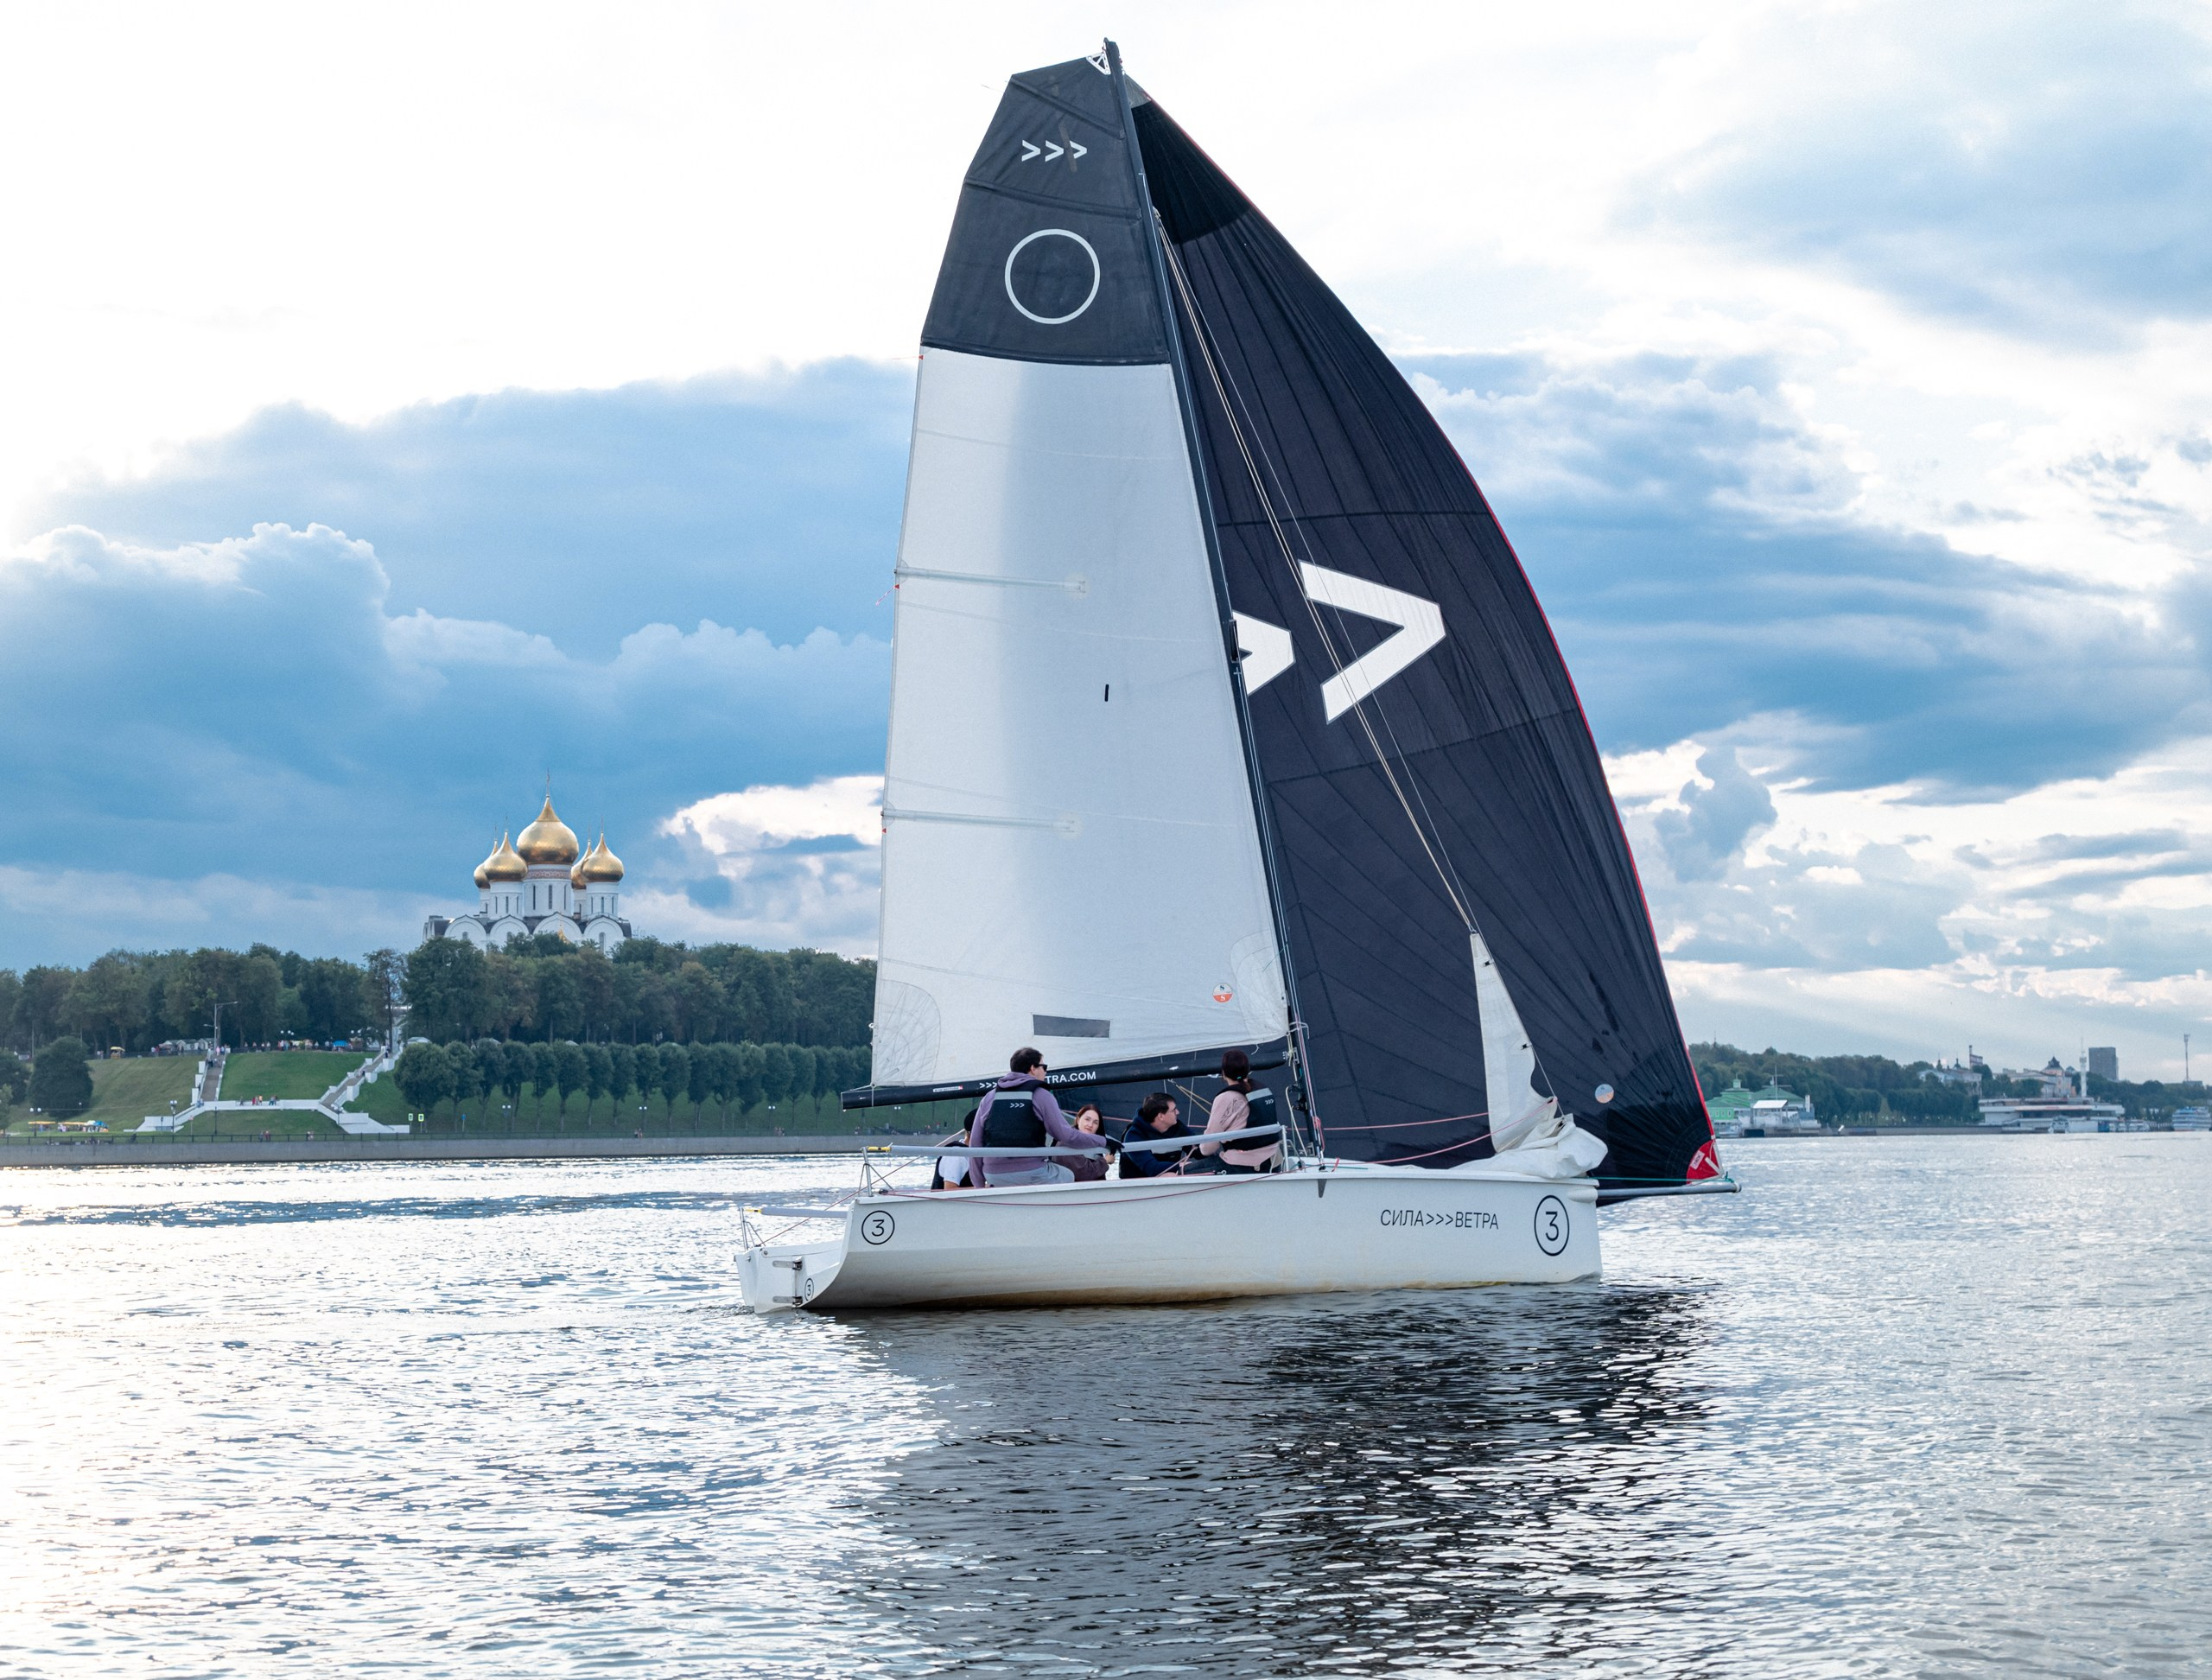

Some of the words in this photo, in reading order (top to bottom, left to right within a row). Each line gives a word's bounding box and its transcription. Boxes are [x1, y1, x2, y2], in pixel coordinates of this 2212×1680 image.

[1045, 1071, 1096, 1085] TRA.COM
[871, 1219, 886, 1237] 3
[1545, 1211, 1560, 1242] 3
[807, 1284, 812, 1296] 3
